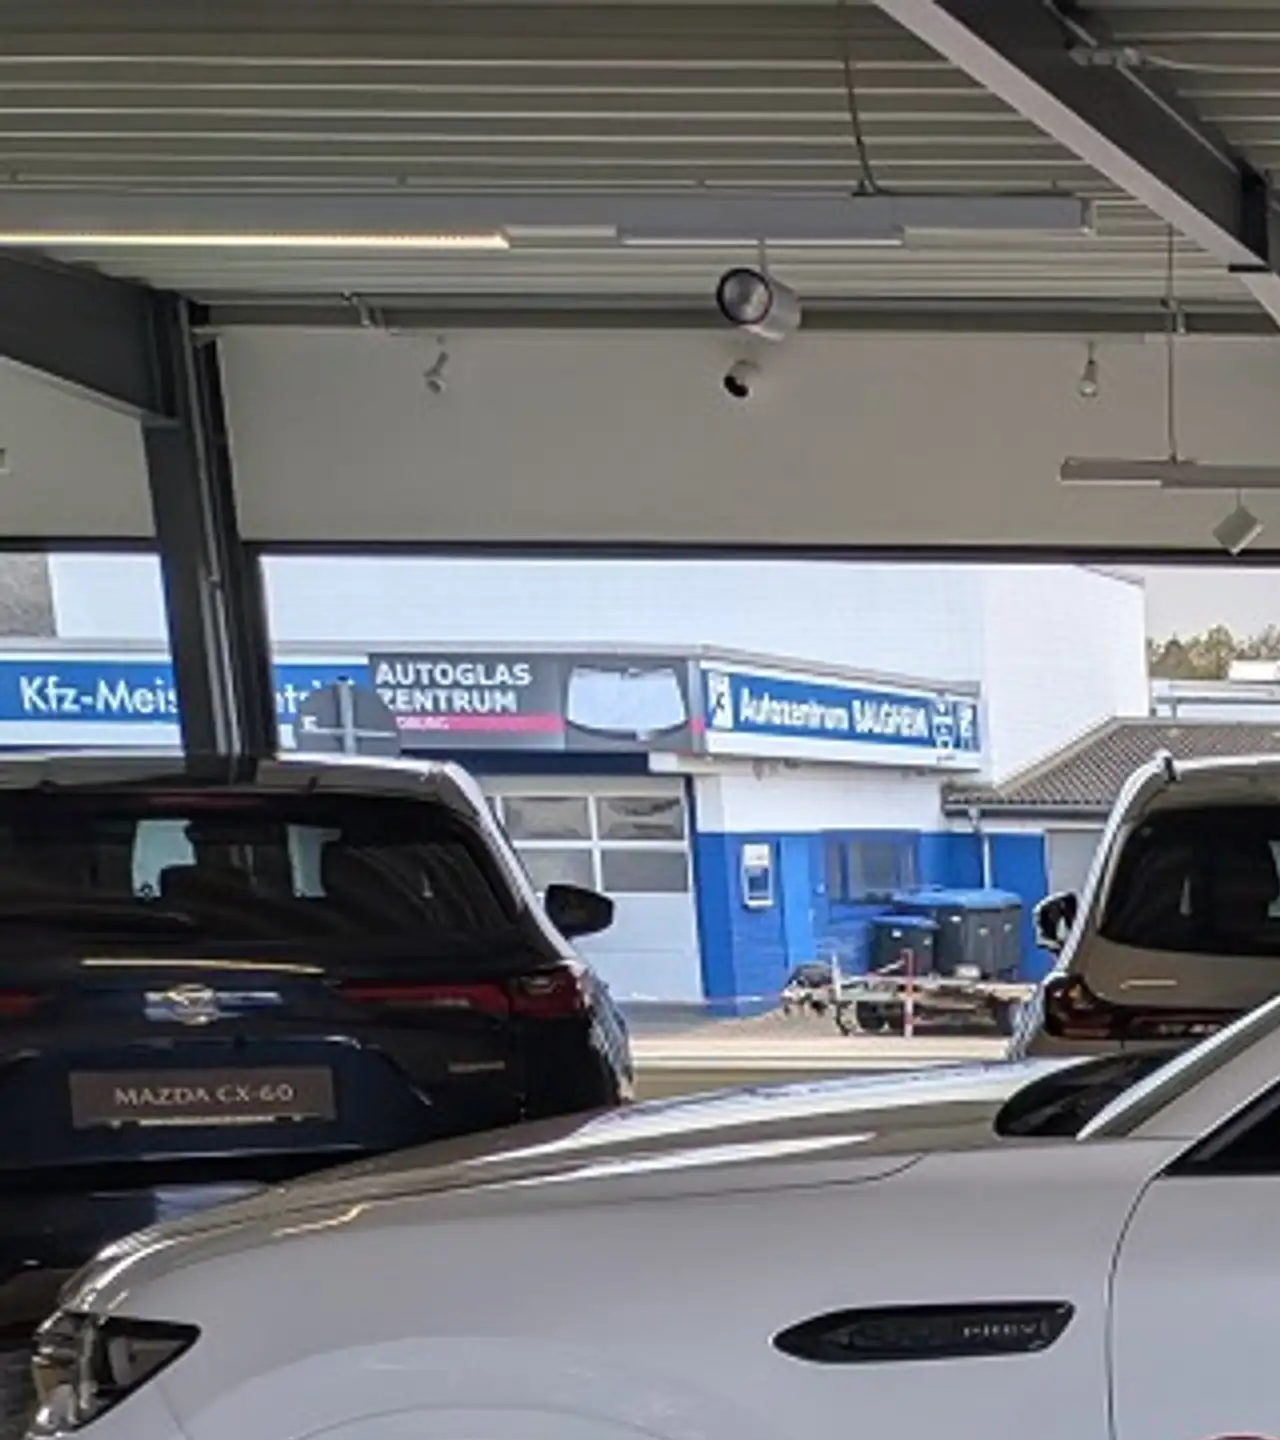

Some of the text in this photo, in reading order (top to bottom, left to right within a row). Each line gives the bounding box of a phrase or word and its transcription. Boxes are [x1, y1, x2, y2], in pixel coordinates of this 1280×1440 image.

[375, 663, 532, 686] AUTOGLAS
[376, 688, 517, 714] ZENTRUM
[114, 1083, 294, 1107] MAZDA CX-60
